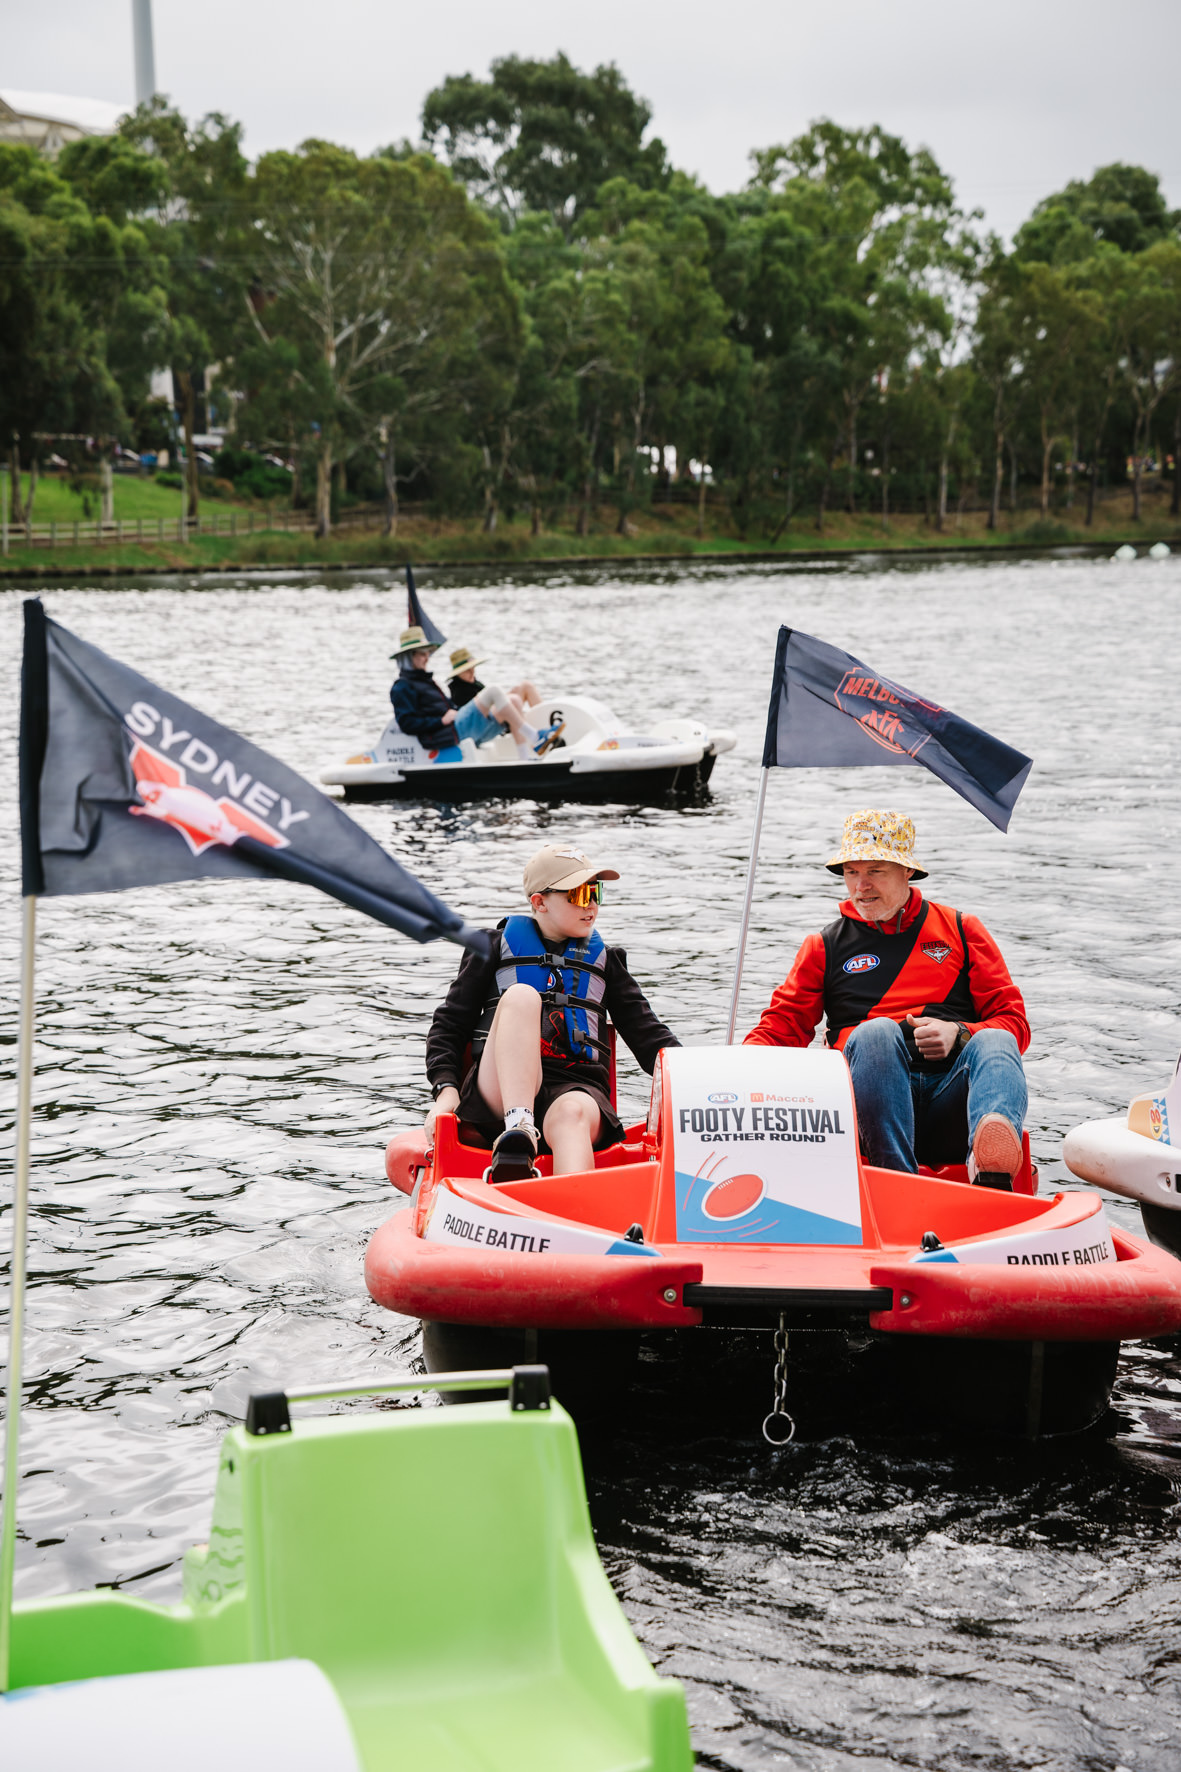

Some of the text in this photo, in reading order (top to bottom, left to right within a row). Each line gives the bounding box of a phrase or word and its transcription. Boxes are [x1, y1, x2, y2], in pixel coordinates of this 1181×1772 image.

[549, 710, 564, 727] 6
[124, 701, 310, 830] SYDNEY
[847, 956, 877, 971] AFL
[710, 1093, 735, 1103] AFL
[766, 1094, 814, 1103] Macca's
[679, 1107, 845, 1134] FOOTY FESTIVAL
[700, 1133, 826, 1143] GATHER ROUND
[443, 1213, 551, 1253] PADDLE BATTLE
[1074, 1240, 1109, 1265] BATTLE
